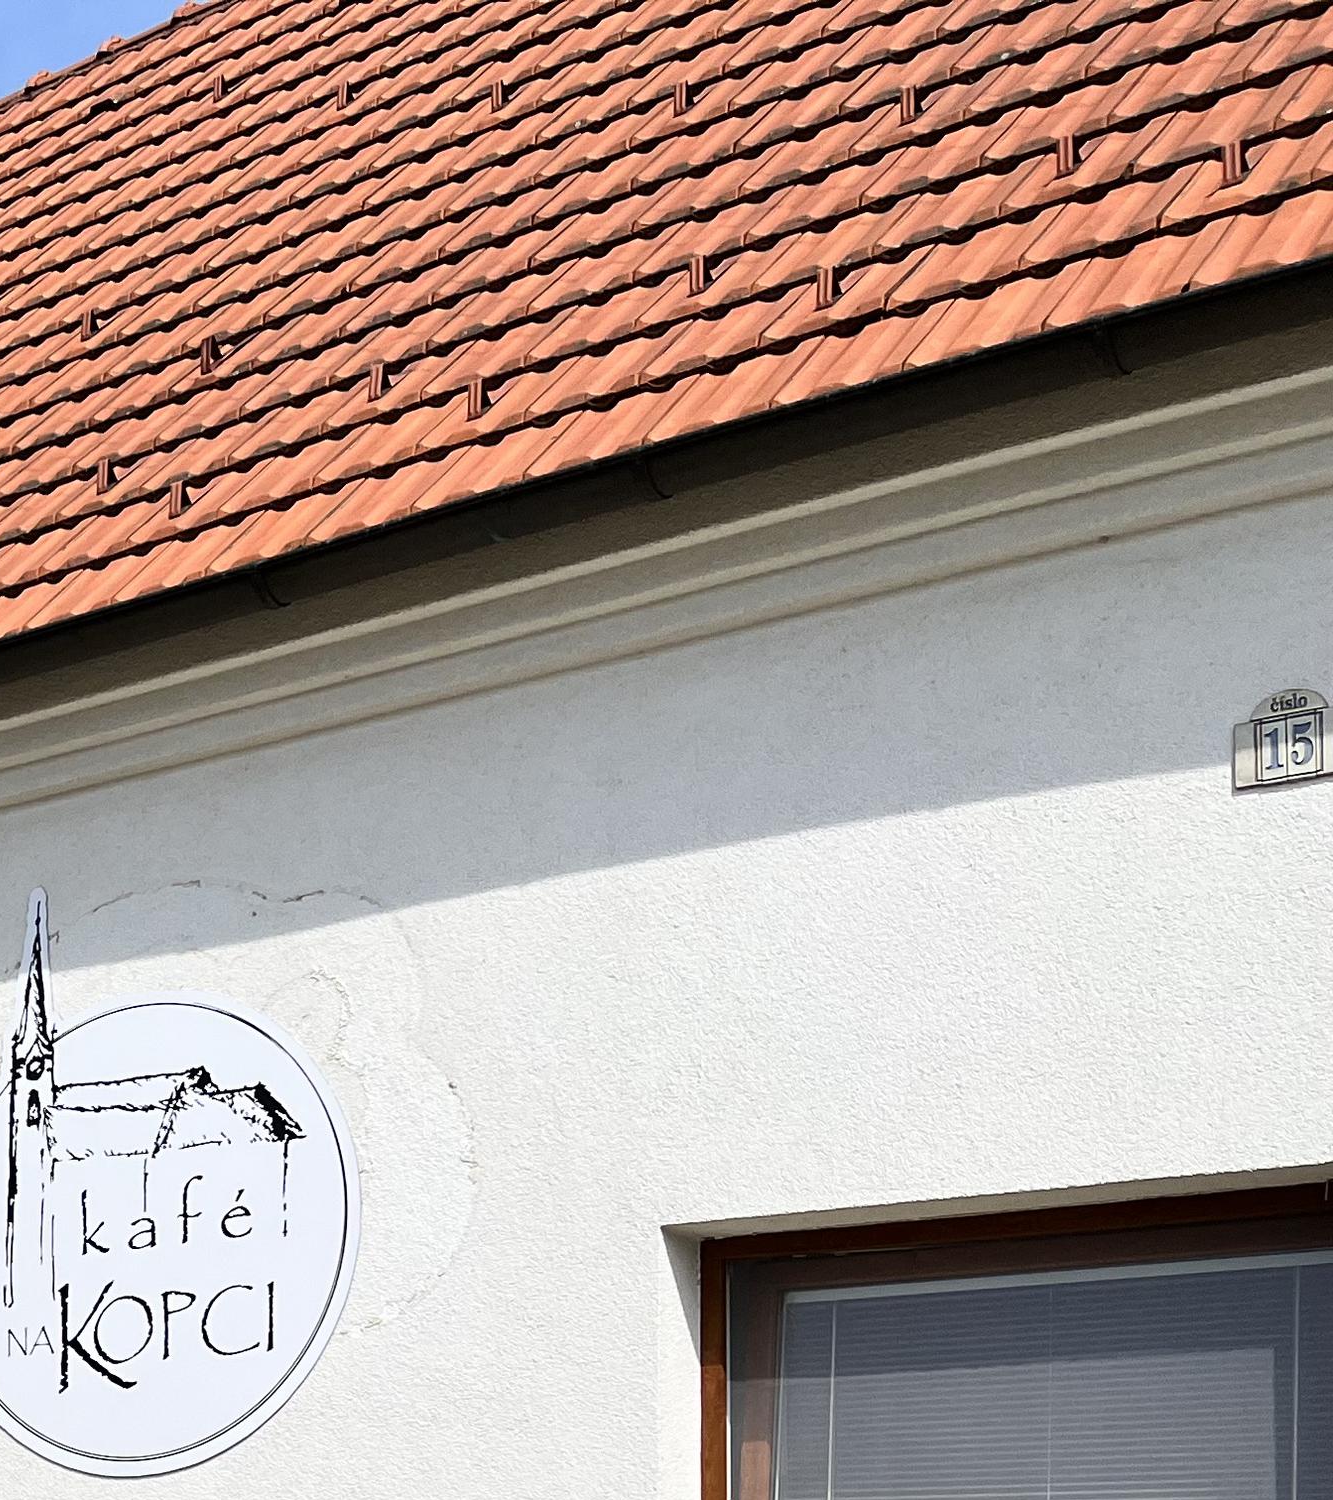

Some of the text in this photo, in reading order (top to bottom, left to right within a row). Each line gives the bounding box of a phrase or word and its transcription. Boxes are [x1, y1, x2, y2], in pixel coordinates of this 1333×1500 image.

[1269, 692, 1309, 713] číslo
[1263, 721, 1315, 770] 15
[81, 1175, 254, 1256] kafé
[7, 1280, 275, 1395] NA KOPCI
